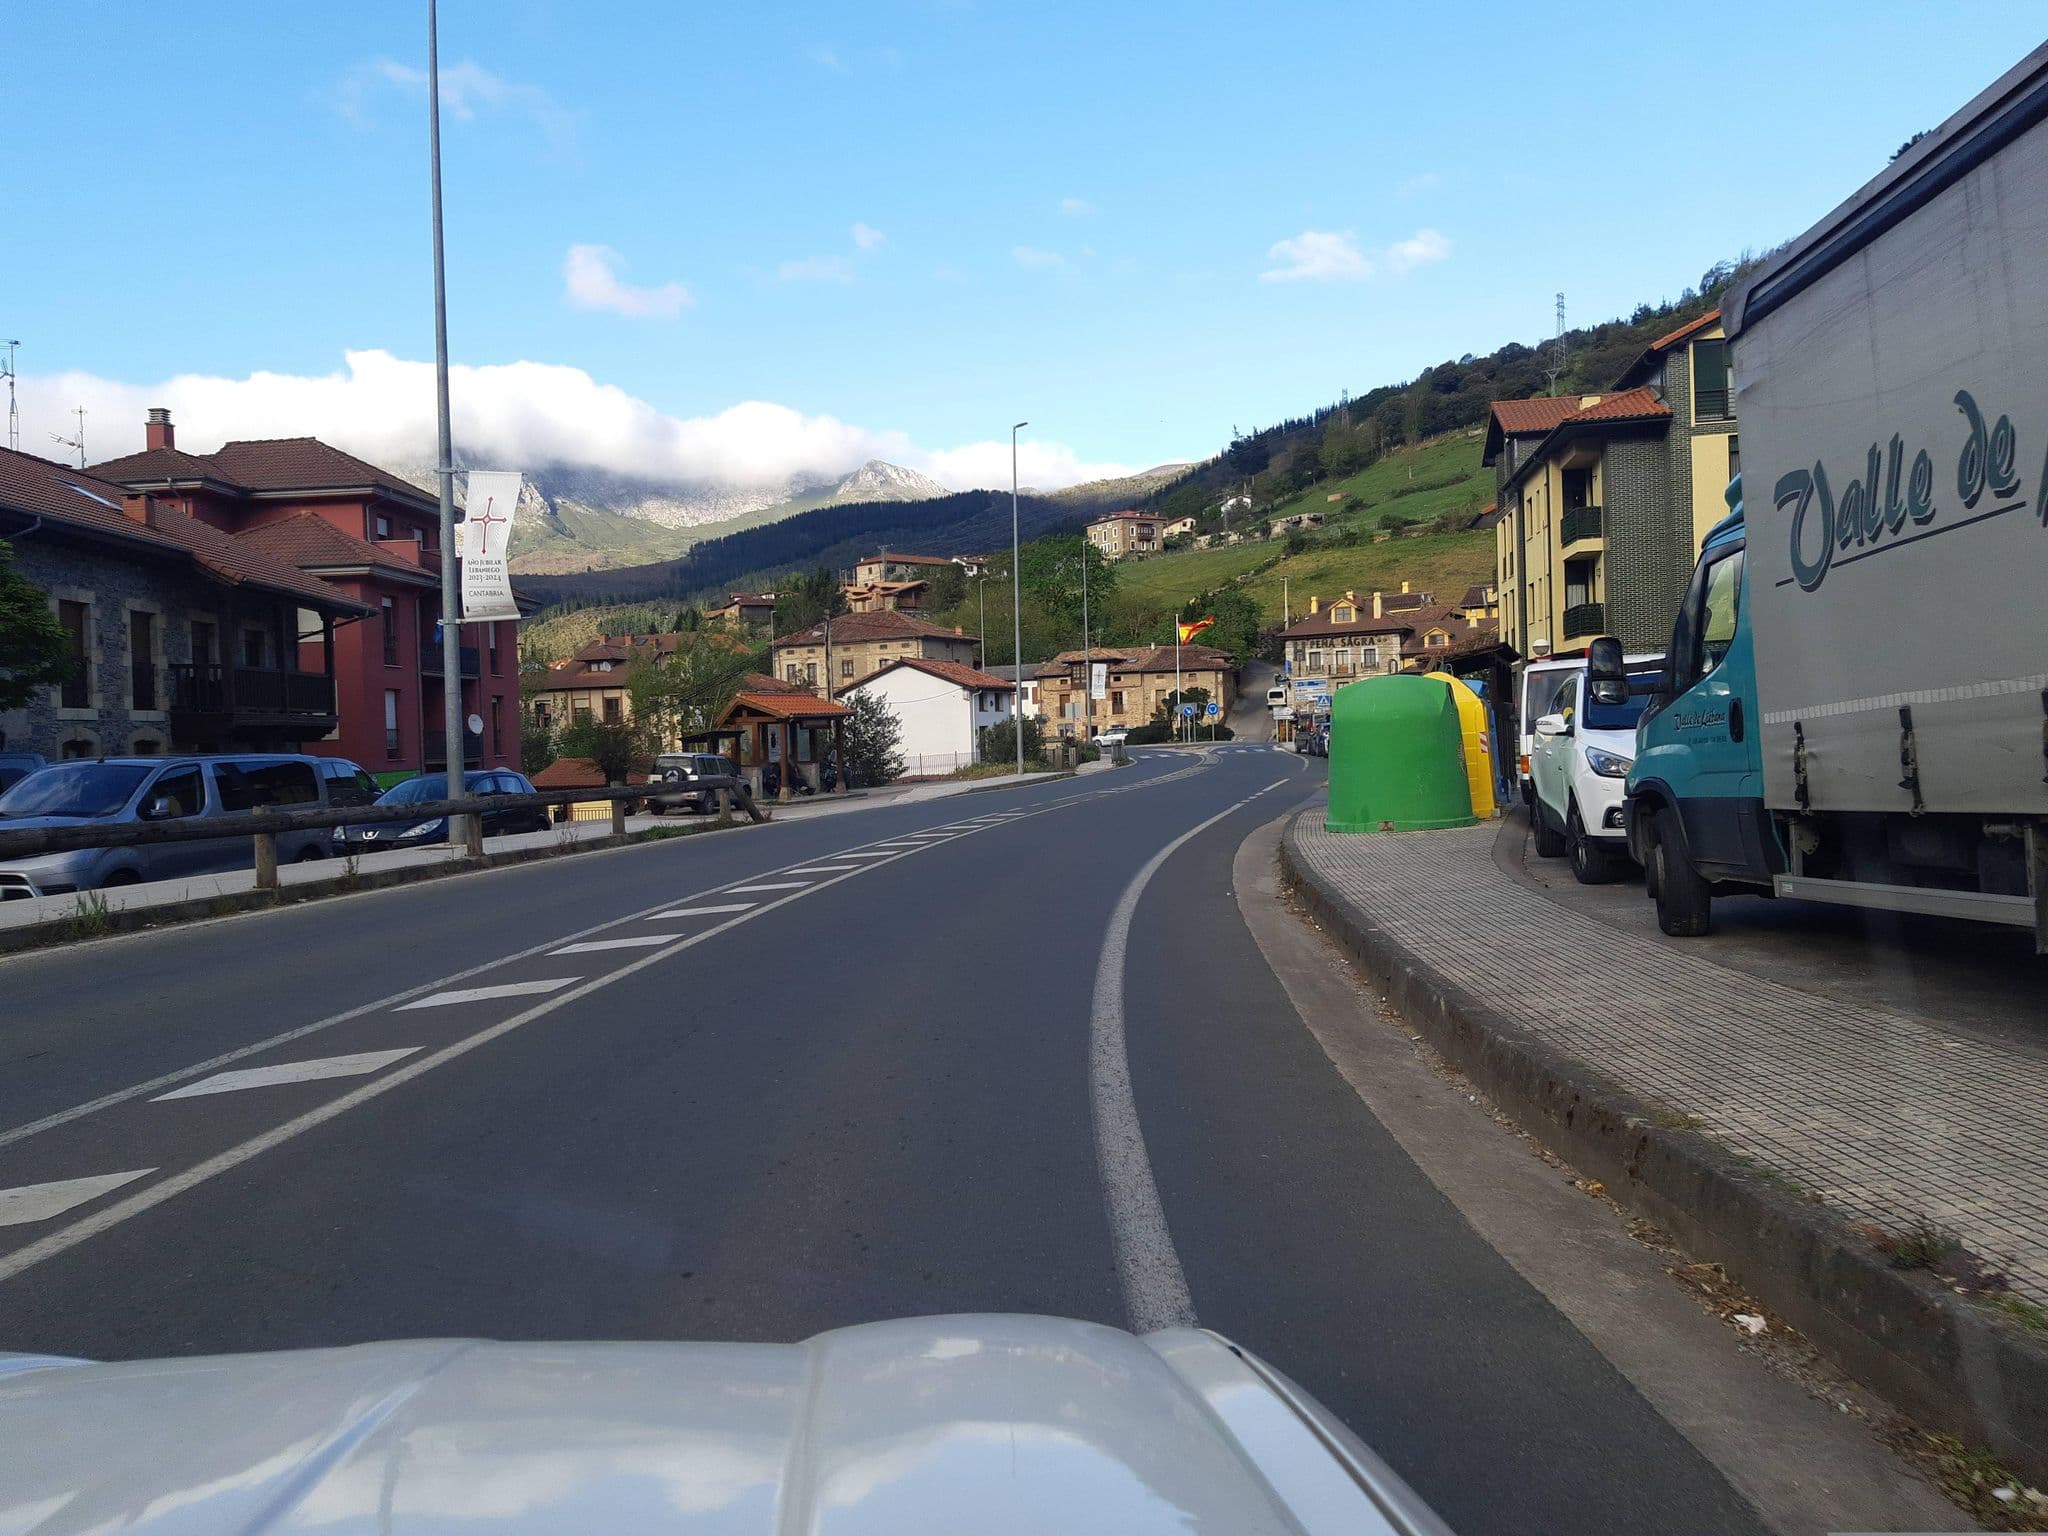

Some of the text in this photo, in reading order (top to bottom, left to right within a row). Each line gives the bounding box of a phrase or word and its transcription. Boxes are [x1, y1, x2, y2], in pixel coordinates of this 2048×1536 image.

[1773, 432, 1936, 592] Valle
[1953, 390, 2021, 509] de
[468, 574, 501, 582] 2023-2024
[1340, 636, 1375, 648] SAGRA
